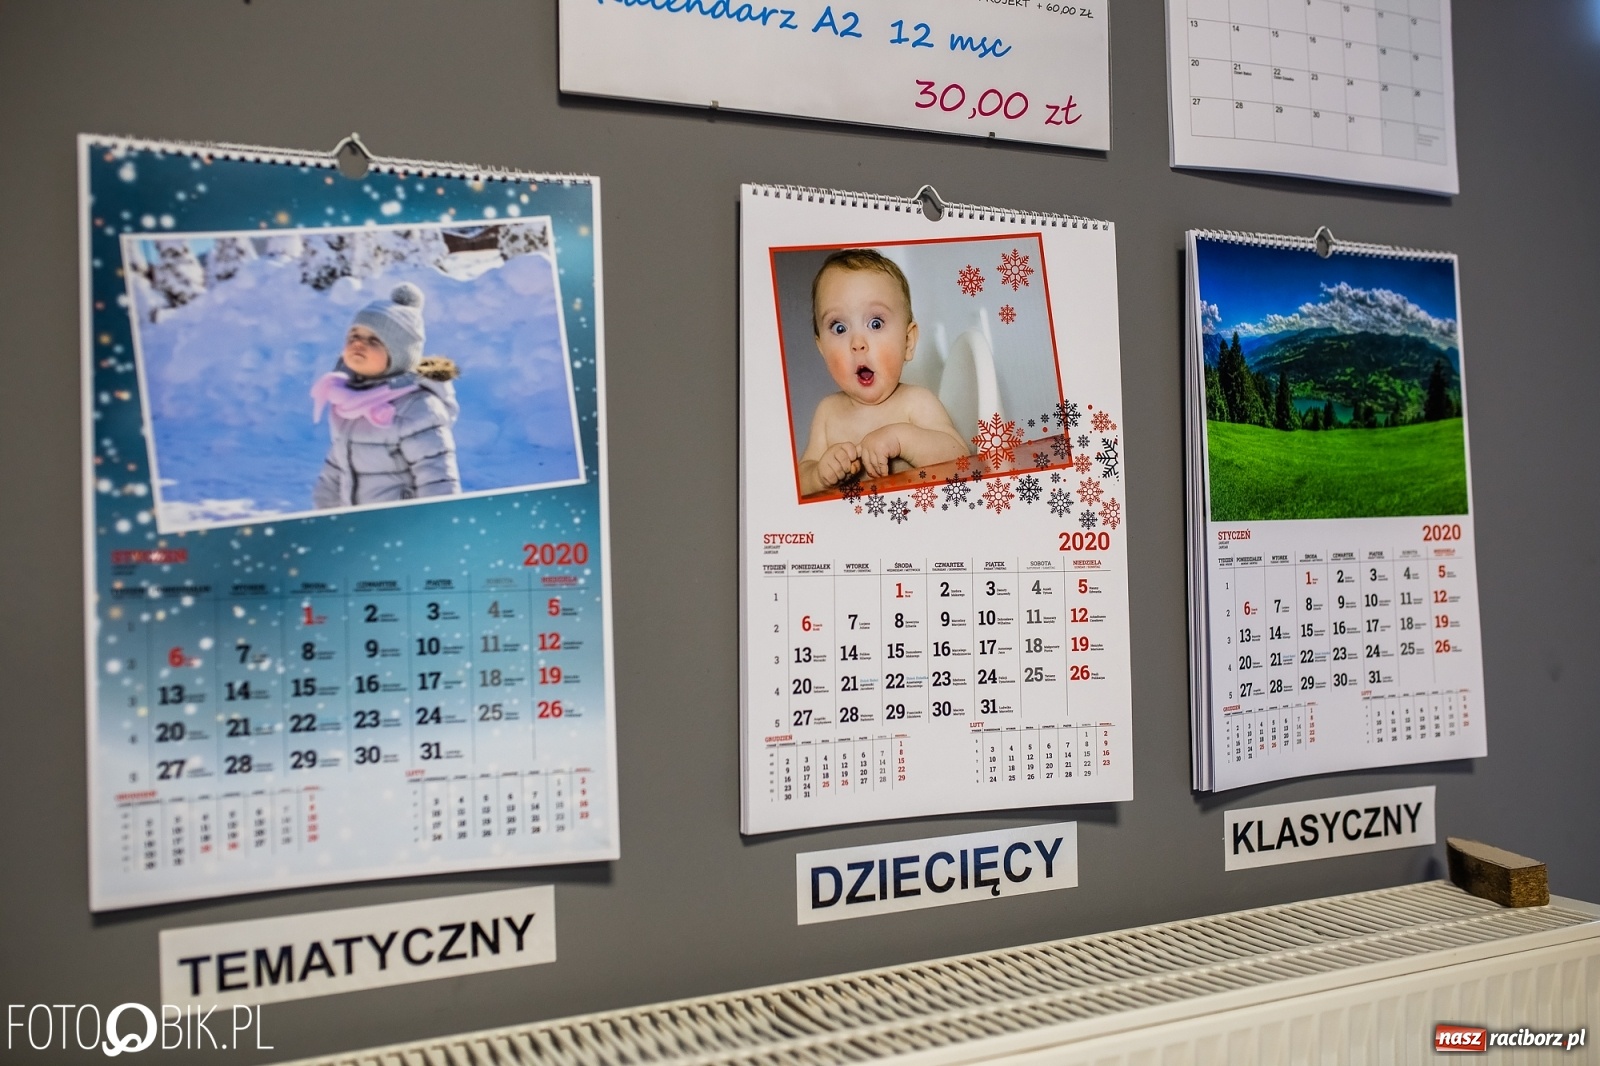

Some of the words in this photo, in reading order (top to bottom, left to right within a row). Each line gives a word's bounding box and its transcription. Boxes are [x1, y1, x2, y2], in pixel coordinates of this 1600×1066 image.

[1046, 3, 1076, 15] 60,00
[812, 6, 862, 38] A2
[890, 19, 935, 49] 12
[949, 32, 1012, 59] msc
[1190, 20, 1198, 28] 13
[1271, 30, 1279, 38] 15
[1309, 36, 1316, 44] 16
[1191, 59, 1199, 67] 20
[1233, 63, 1241, 71] 21
[1273, 68, 1281, 76] 22
[1311, 73, 1318, 81] 23
[913, 78, 1029, 120] 30,00
[1044, 94, 1083, 126] zł
[1192, 98, 1201, 106] 27
[1235, 101, 1243, 109] 28
[1275, 106, 1283, 114] 29
[1313, 111, 1320, 119] 30
[763, 532, 814, 544] STYCZEŃ
[1058, 532, 1110, 551] 2020
[1218, 528, 1250, 540] STYCZEŃ
[1422, 524, 1462, 541] 2020
[522, 542, 589, 566] 2020
[1306, 571, 1311, 585] 1
[1336, 569, 1344, 583] 2
[1370, 568, 1377, 581] 3
[1404, 567, 1411, 580] 4
[1438, 565, 1446, 578] 5
[774, 593, 778, 601] 1
[895, 582, 904, 598] 1
[940, 581, 950, 597] 2
[985, 580, 995, 596] 3
[1031, 580, 1042, 595] 4
[1078, 578, 1088, 594] 5
[1244, 601, 1250, 615] 6
[1274, 599, 1281, 613] 7
[1306, 597, 1312, 611] 8
[1338, 595, 1345, 609] 9
[1365, 594, 1378, 607] 10
[1400, 592, 1412, 605] 11
[1433, 590, 1447, 603] 12
[303, 605, 314, 625] 1
[364, 604, 378, 623] 2
[427, 602, 440, 620] 3
[488, 600, 500, 618] 4
[547, 598, 560, 617] 5
[774, 625, 779, 633] 2
[801, 615, 812, 632] 6
[848, 614, 858, 630] 7
[894, 612, 904, 628] 8
[940, 611, 950, 627] 9
[978, 610, 996, 625] 10
[1026, 609, 1042, 624] 11
[1070, 607, 1088, 623] 12
[1240, 628, 1251, 643] 13
[1269, 626, 1282, 640] 14
[1301, 623, 1313, 637] 15
[1333, 621, 1346, 635] 16
[1366, 619, 1379, 632] 17
[1400, 616, 1413, 630] 18
[1435, 615, 1449, 628] 19
[168, 647, 184, 668] 6
[235, 644, 252, 663] 7
[302, 642, 315, 661] 8
[365, 639, 379, 658] 9
[416, 637, 440, 656] 10
[481, 635, 501, 653] 11
[538, 632, 561, 651] 12
[774, 656, 779, 664] 3
[794, 647, 812, 663] 13
[840, 645, 858, 661] 14
[887, 643, 905, 659] 15
[933, 641, 950, 657] 16
[979, 639, 997, 655] 17
[1025, 638, 1042, 653] 18
[1071, 636, 1089, 651] 19
[1239, 655, 1252, 670] 20
[1270, 652, 1282, 666] 21
[1300, 649, 1314, 664] 22
[1333, 647, 1347, 661] 23
[1366, 644, 1380, 658] 24
[1400, 642, 1415, 655] 25
[1435, 640, 1451, 654] 26
[158, 684, 185, 706] 13
[225, 681, 250, 701] 14
[291, 677, 316, 697] 15
[355, 674, 380, 694] 16
[418, 672, 442, 690] 17
[479, 669, 502, 687] 18
[538, 666, 562, 685] 19
[775, 688, 779, 696] 4
[792, 678, 812, 694] 20
[840, 675, 858, 692] 21
[885, 673, 905, 689] 22
[932, 671, 951, 686] 23
[977, 669, 997, 684] 24
[1024, 667, 1043, 682] 25
[1070, 665, 1090, 681] 26
[1240, 683, 1253, 697] 27
[1270, 679, 1283, 694] 28
[1301, 676, 1314, 690] 29
[1333, 673, 1347, 687] 30
[1369, 670, 1382, 684] 31
[156, 721, 185, 743] 20
[226, 718, 251, 738] 21
[289, 713, 317, 733] 22
[354, 710, 381, 729] 23
[416, 707, 442, 726] 24
[478, 704, 503, 722] 25
[537, 700, 563, 719] 26
[775, 719, 780, 728] 5
[793, 709, 813, 726] 27
[839, 706, 859, 723] 28
[886, 704, 905, 720] 29
[932, 701, 951, 717] 30
[980, 699, 998, 714] 31
[157, 759, 186, 781] 27
[225, 755, 252, 775] 28
[290, 750, 317, 770] 29
[355, 746, 381, 765] 30
[420, 742, 443, 760] 31
[1232, 801, 1422, 855] KLASYCZNY
[811, 837, 1064, 910] DZIECIĘCY
[178, 913, 535, 997] TEMATYCZNY
